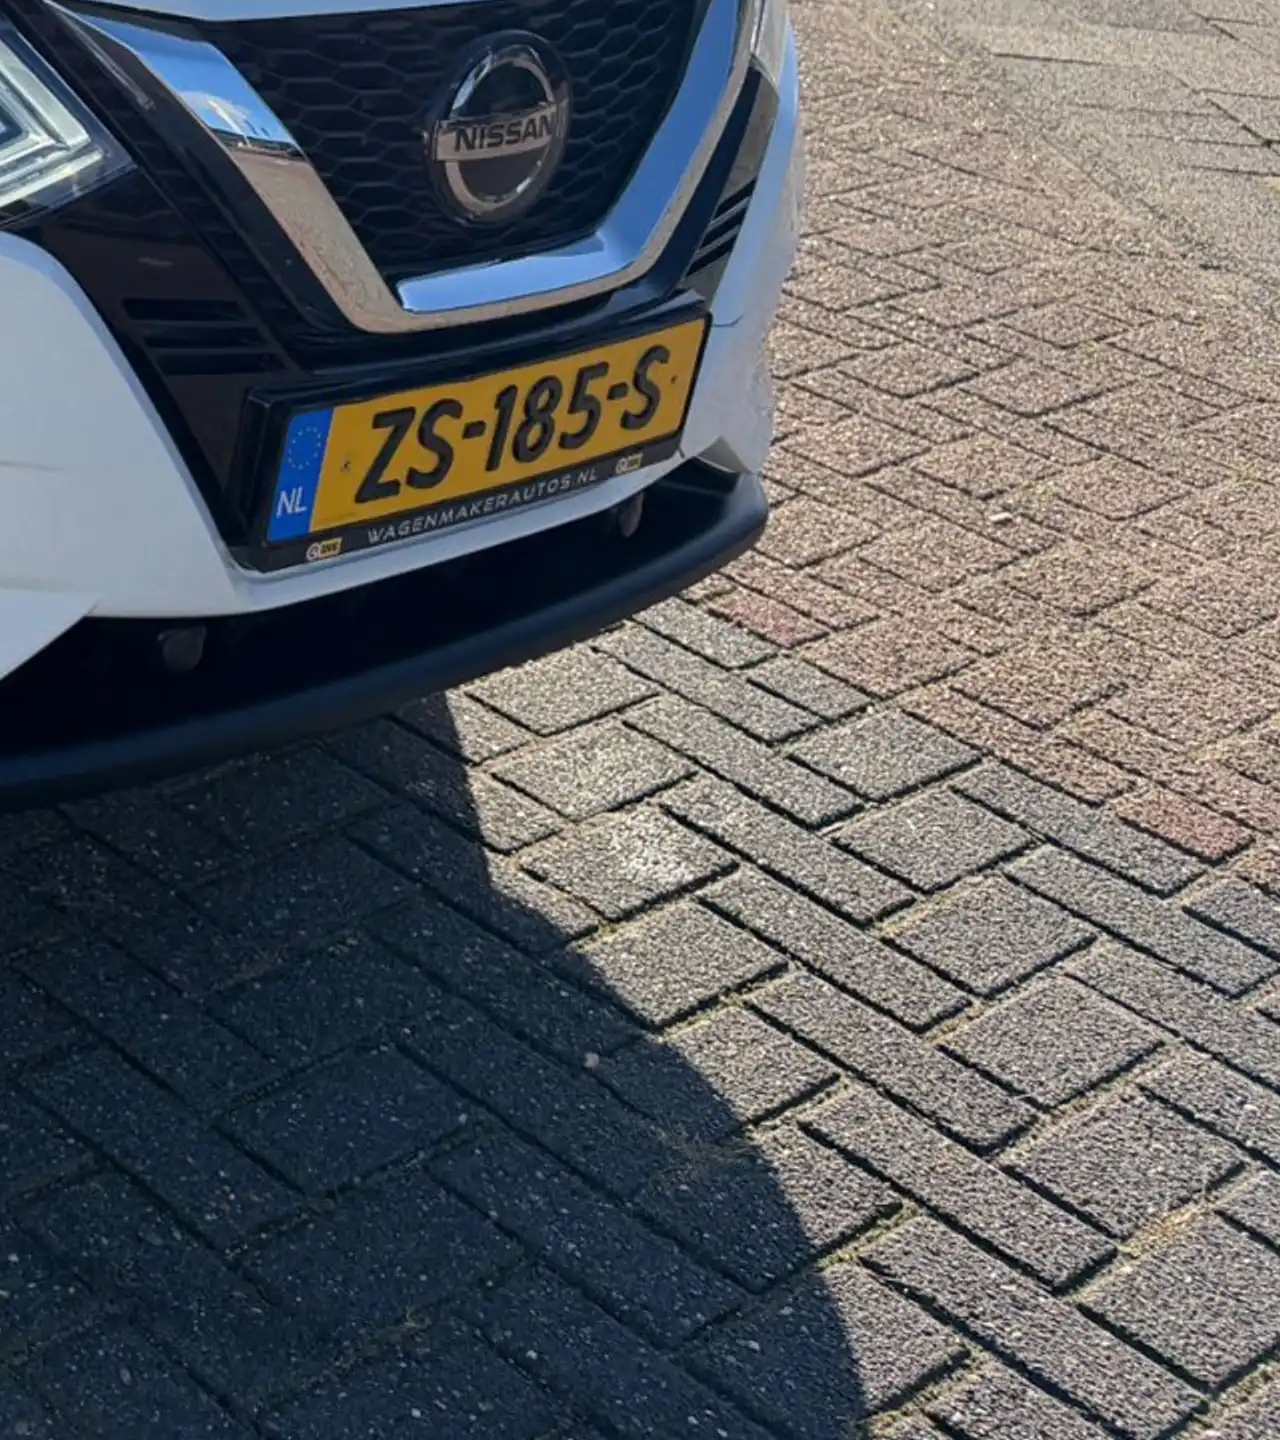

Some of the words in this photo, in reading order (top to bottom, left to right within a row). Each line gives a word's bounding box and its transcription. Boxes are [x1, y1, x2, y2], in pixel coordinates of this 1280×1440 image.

[453, 112, 557, 152] NISSAN
[353, 344, 670, 505] ZS-185-S
[276, 485, 308, 518] NL
[367, 469, 598, 544] WAGENMAKERAUTOS.NL
